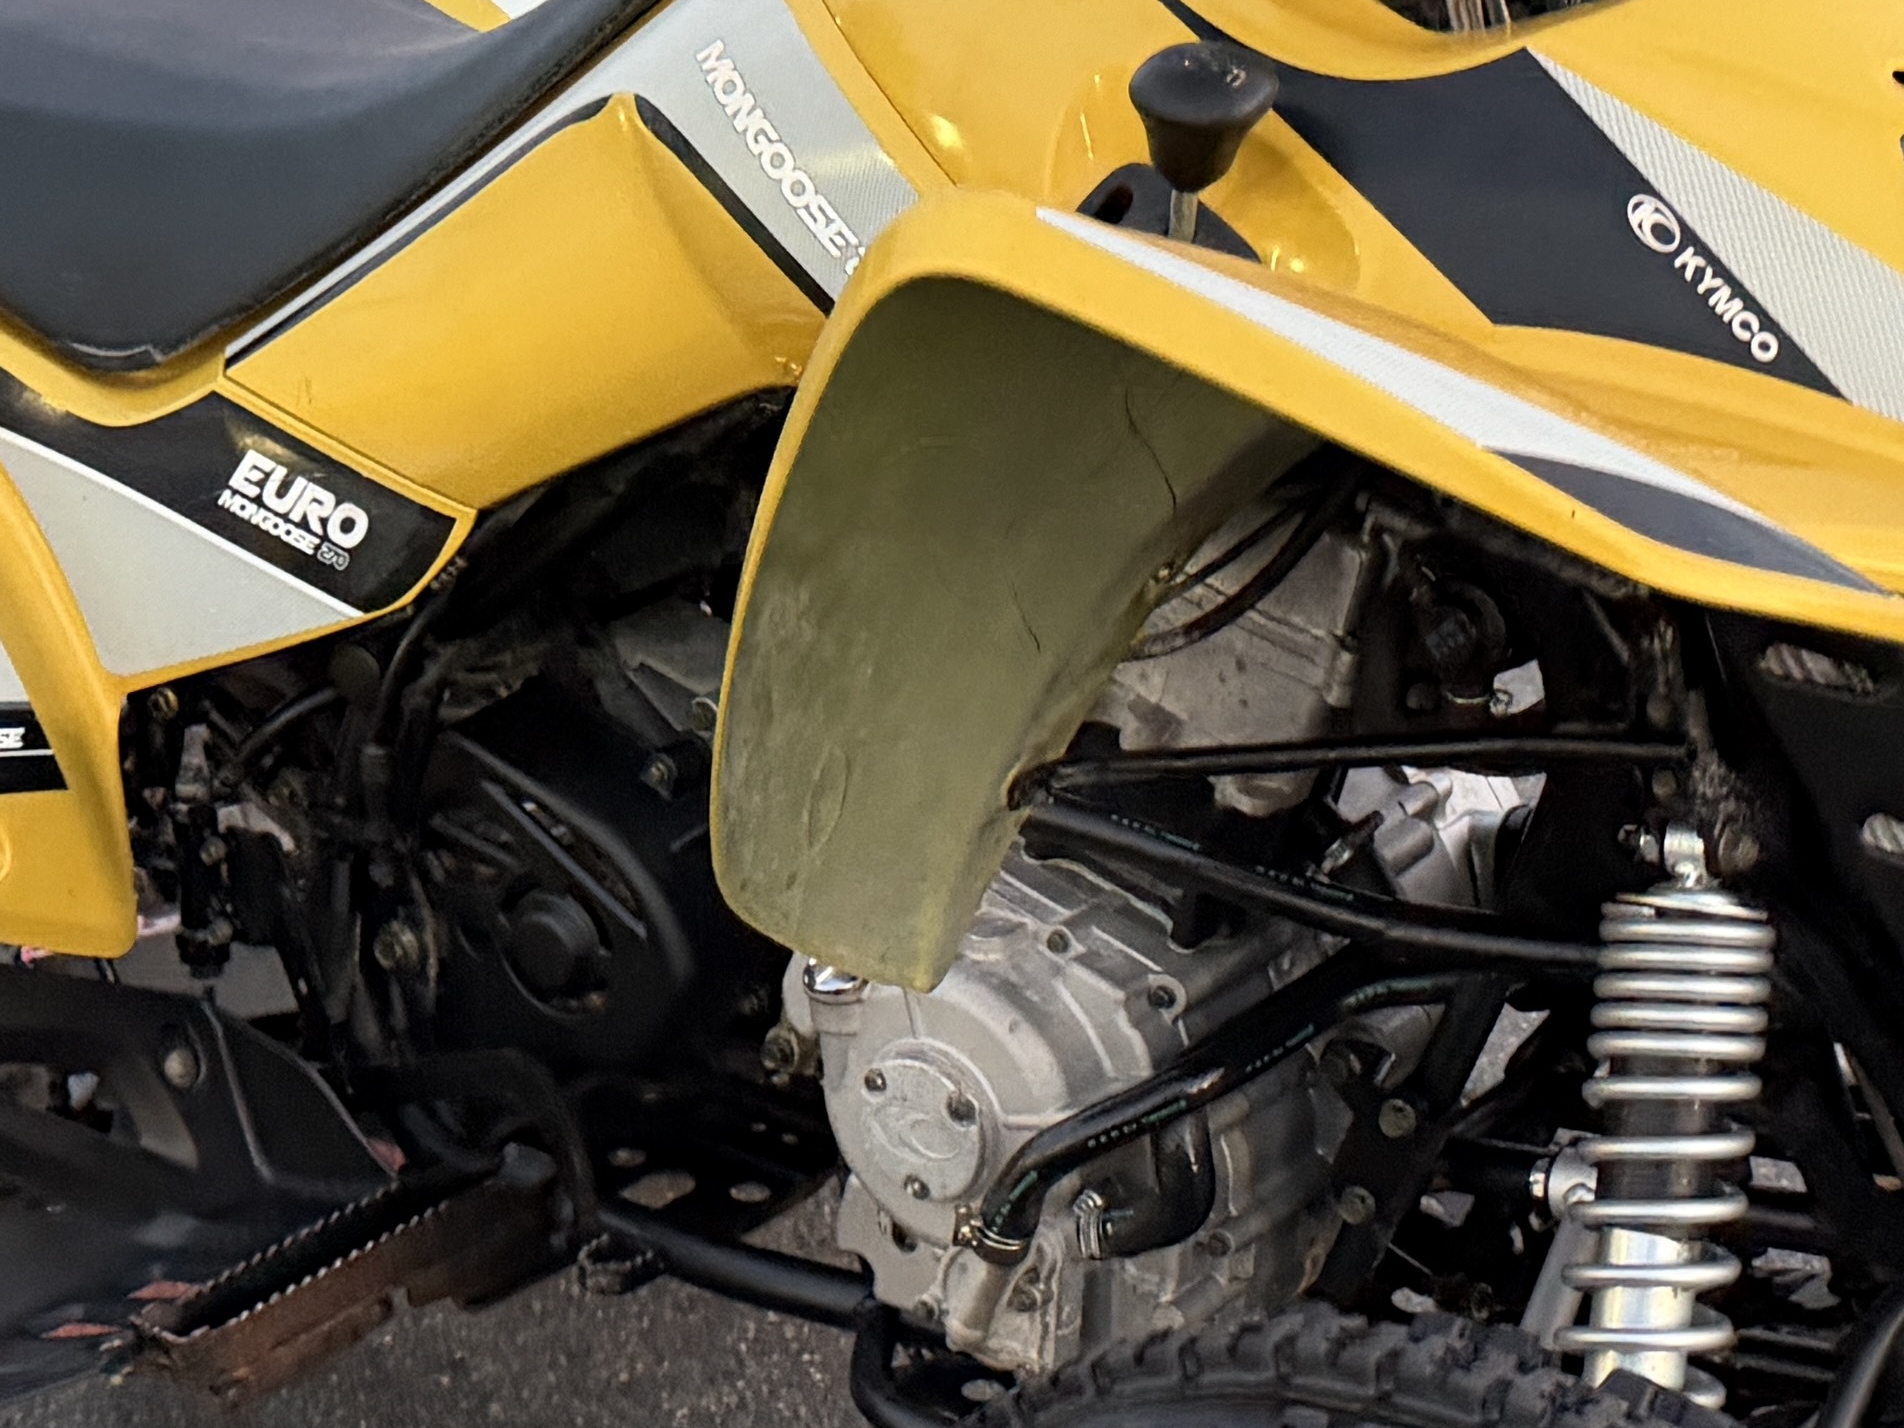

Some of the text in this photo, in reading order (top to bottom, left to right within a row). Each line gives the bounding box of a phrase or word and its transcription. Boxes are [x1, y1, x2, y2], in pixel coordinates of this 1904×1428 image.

[696, 39, 859, 258] MONGOOSE
[1674, 245, 1779, 363] KYMCO
[217, 488, 321, 555] MONGOOSE
[228, 449, 369, 549] EURO
